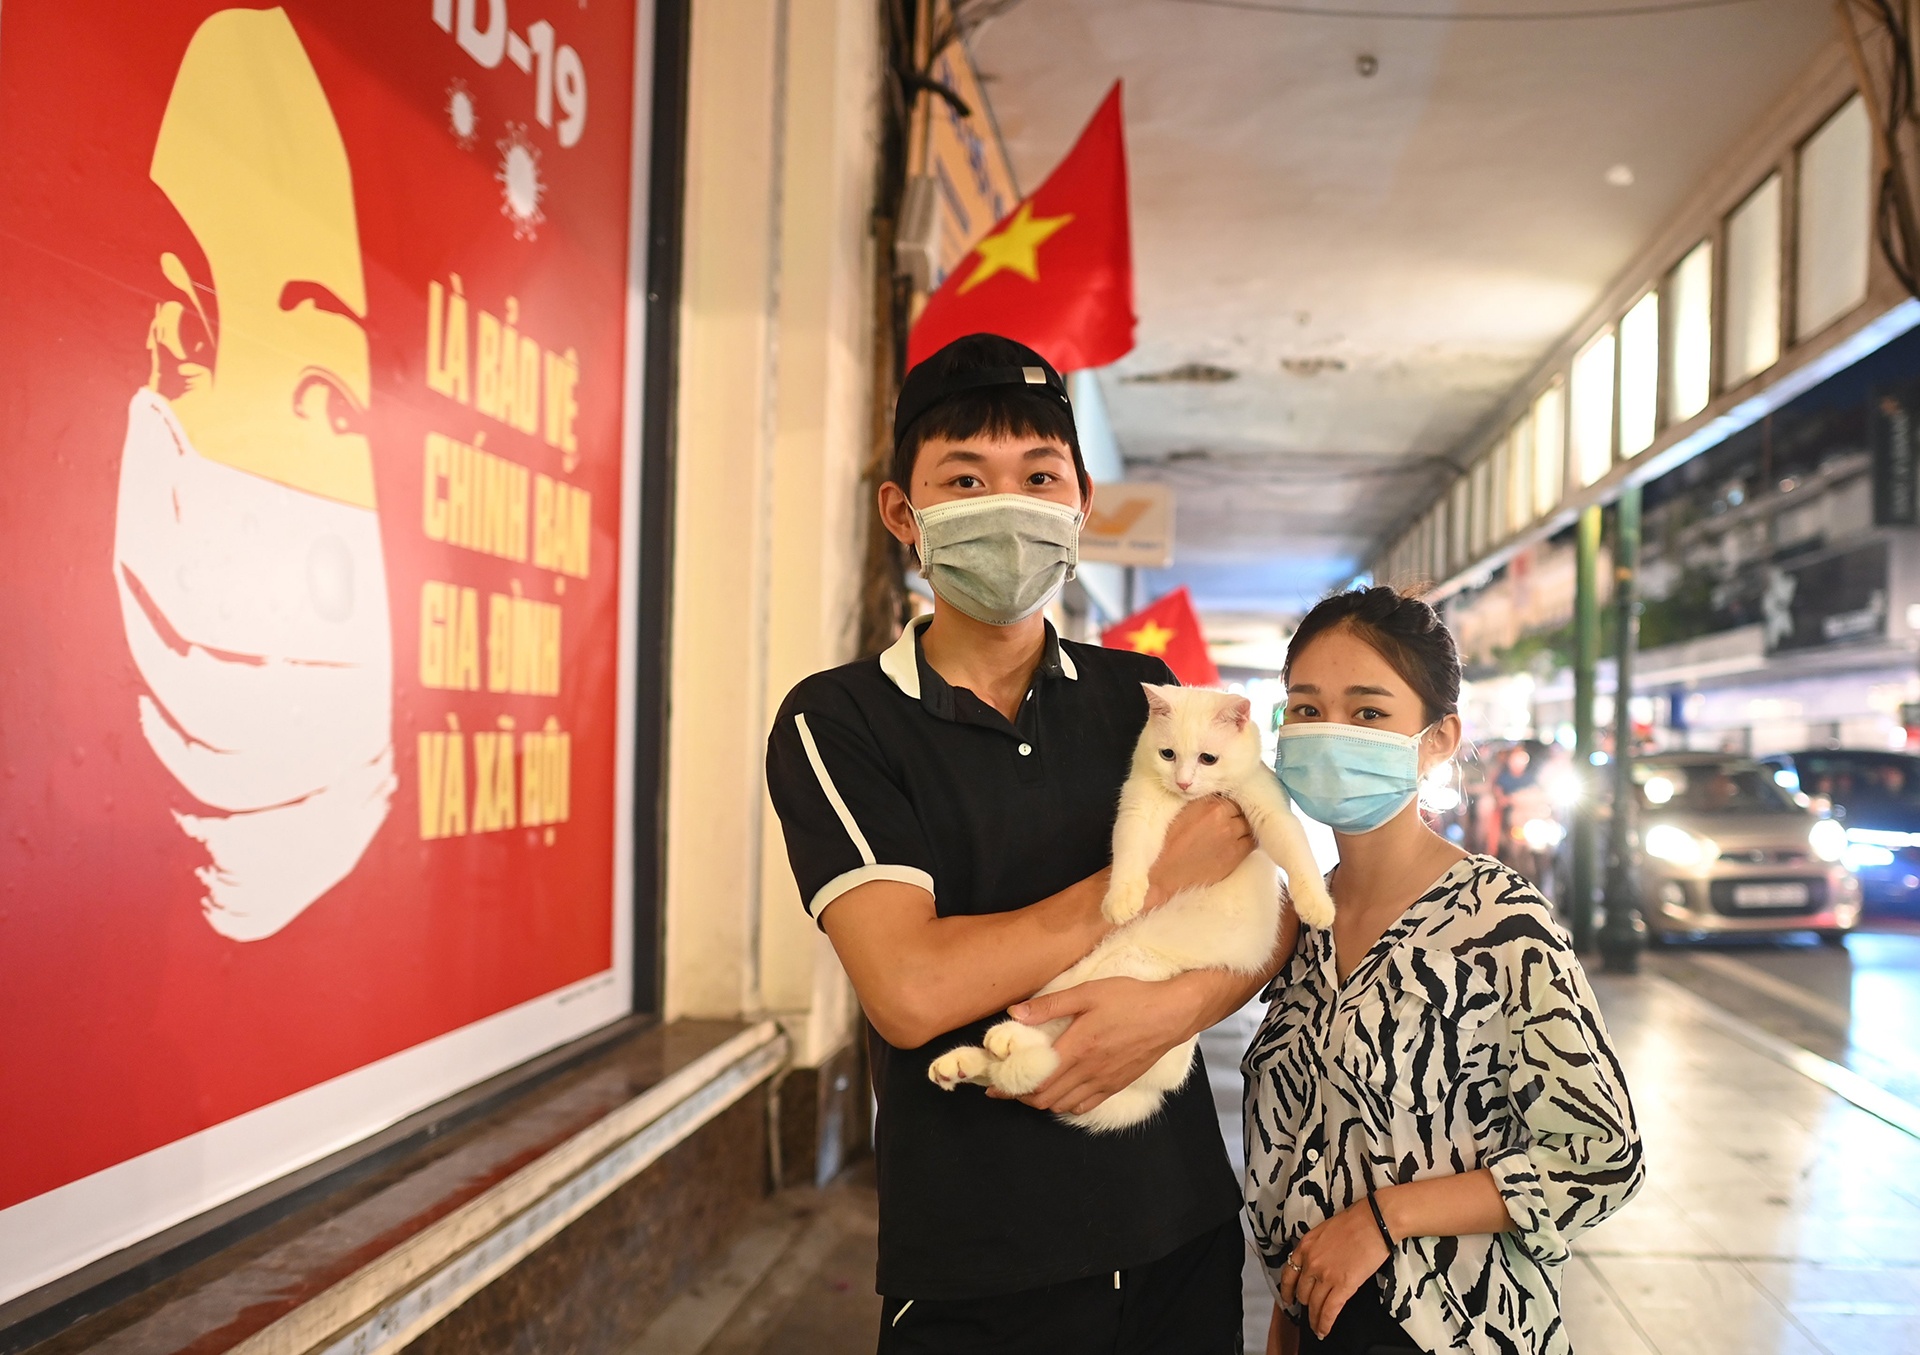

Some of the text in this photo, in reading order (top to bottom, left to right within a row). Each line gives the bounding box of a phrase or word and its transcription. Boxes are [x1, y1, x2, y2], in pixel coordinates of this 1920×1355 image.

[432, 0, 587, 148] D-19
[427, 272, 579, 473] LÀ BẢO VỆ
[423, 430, 591, 596] CHÍNH BẠN
[419, 578, 561, 697] GIA ĐÌNH
[417, 711, 570, 847] VÀ XÃ HỘI
